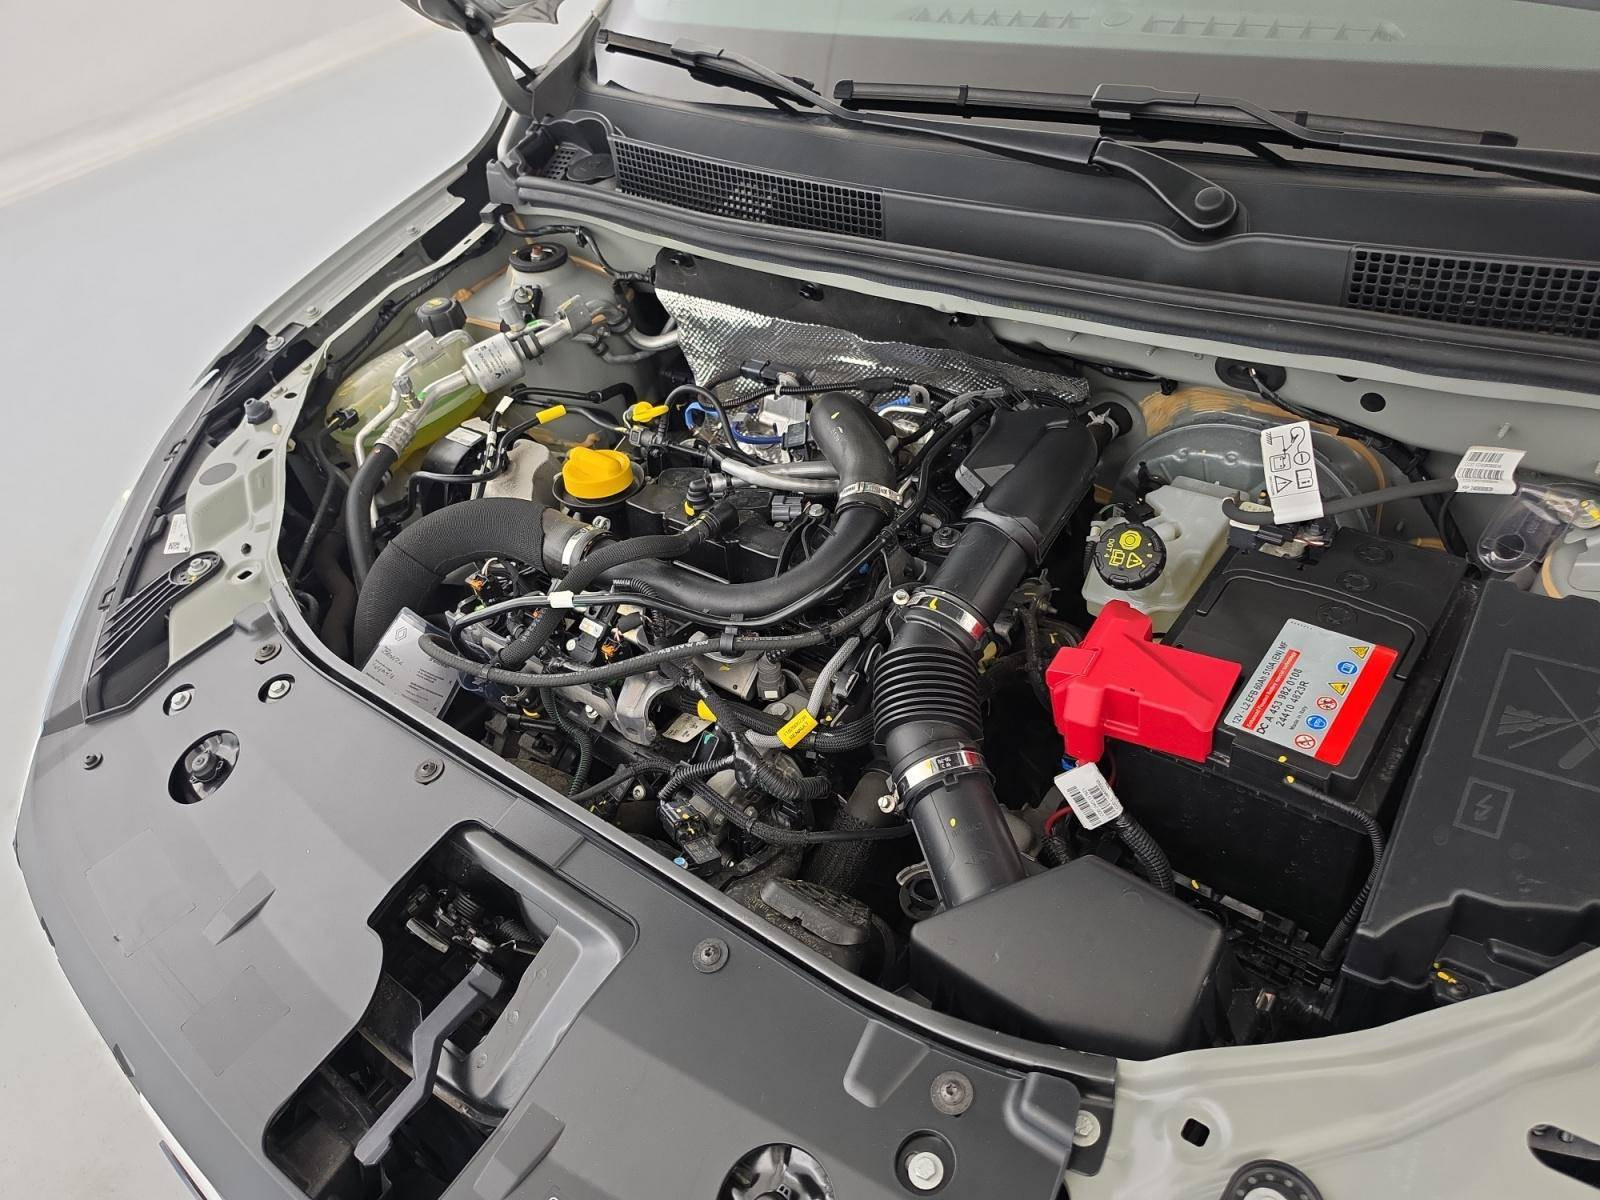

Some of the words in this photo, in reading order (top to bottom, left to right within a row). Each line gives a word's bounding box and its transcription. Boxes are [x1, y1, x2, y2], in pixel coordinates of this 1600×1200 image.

[1106, 538, 1116, 553] DOT
[1240, 701, 1250, 711] L2
[1246, 689, 1259, 703] EFB
[1257, 722, 1269, 735] DC
[1265, 715, 1274, 723] A
[1270, 700, 1283, 715] 453
[1278, 686, 1291, 700] 982
[1276, 704, 1295, 728] 24410
